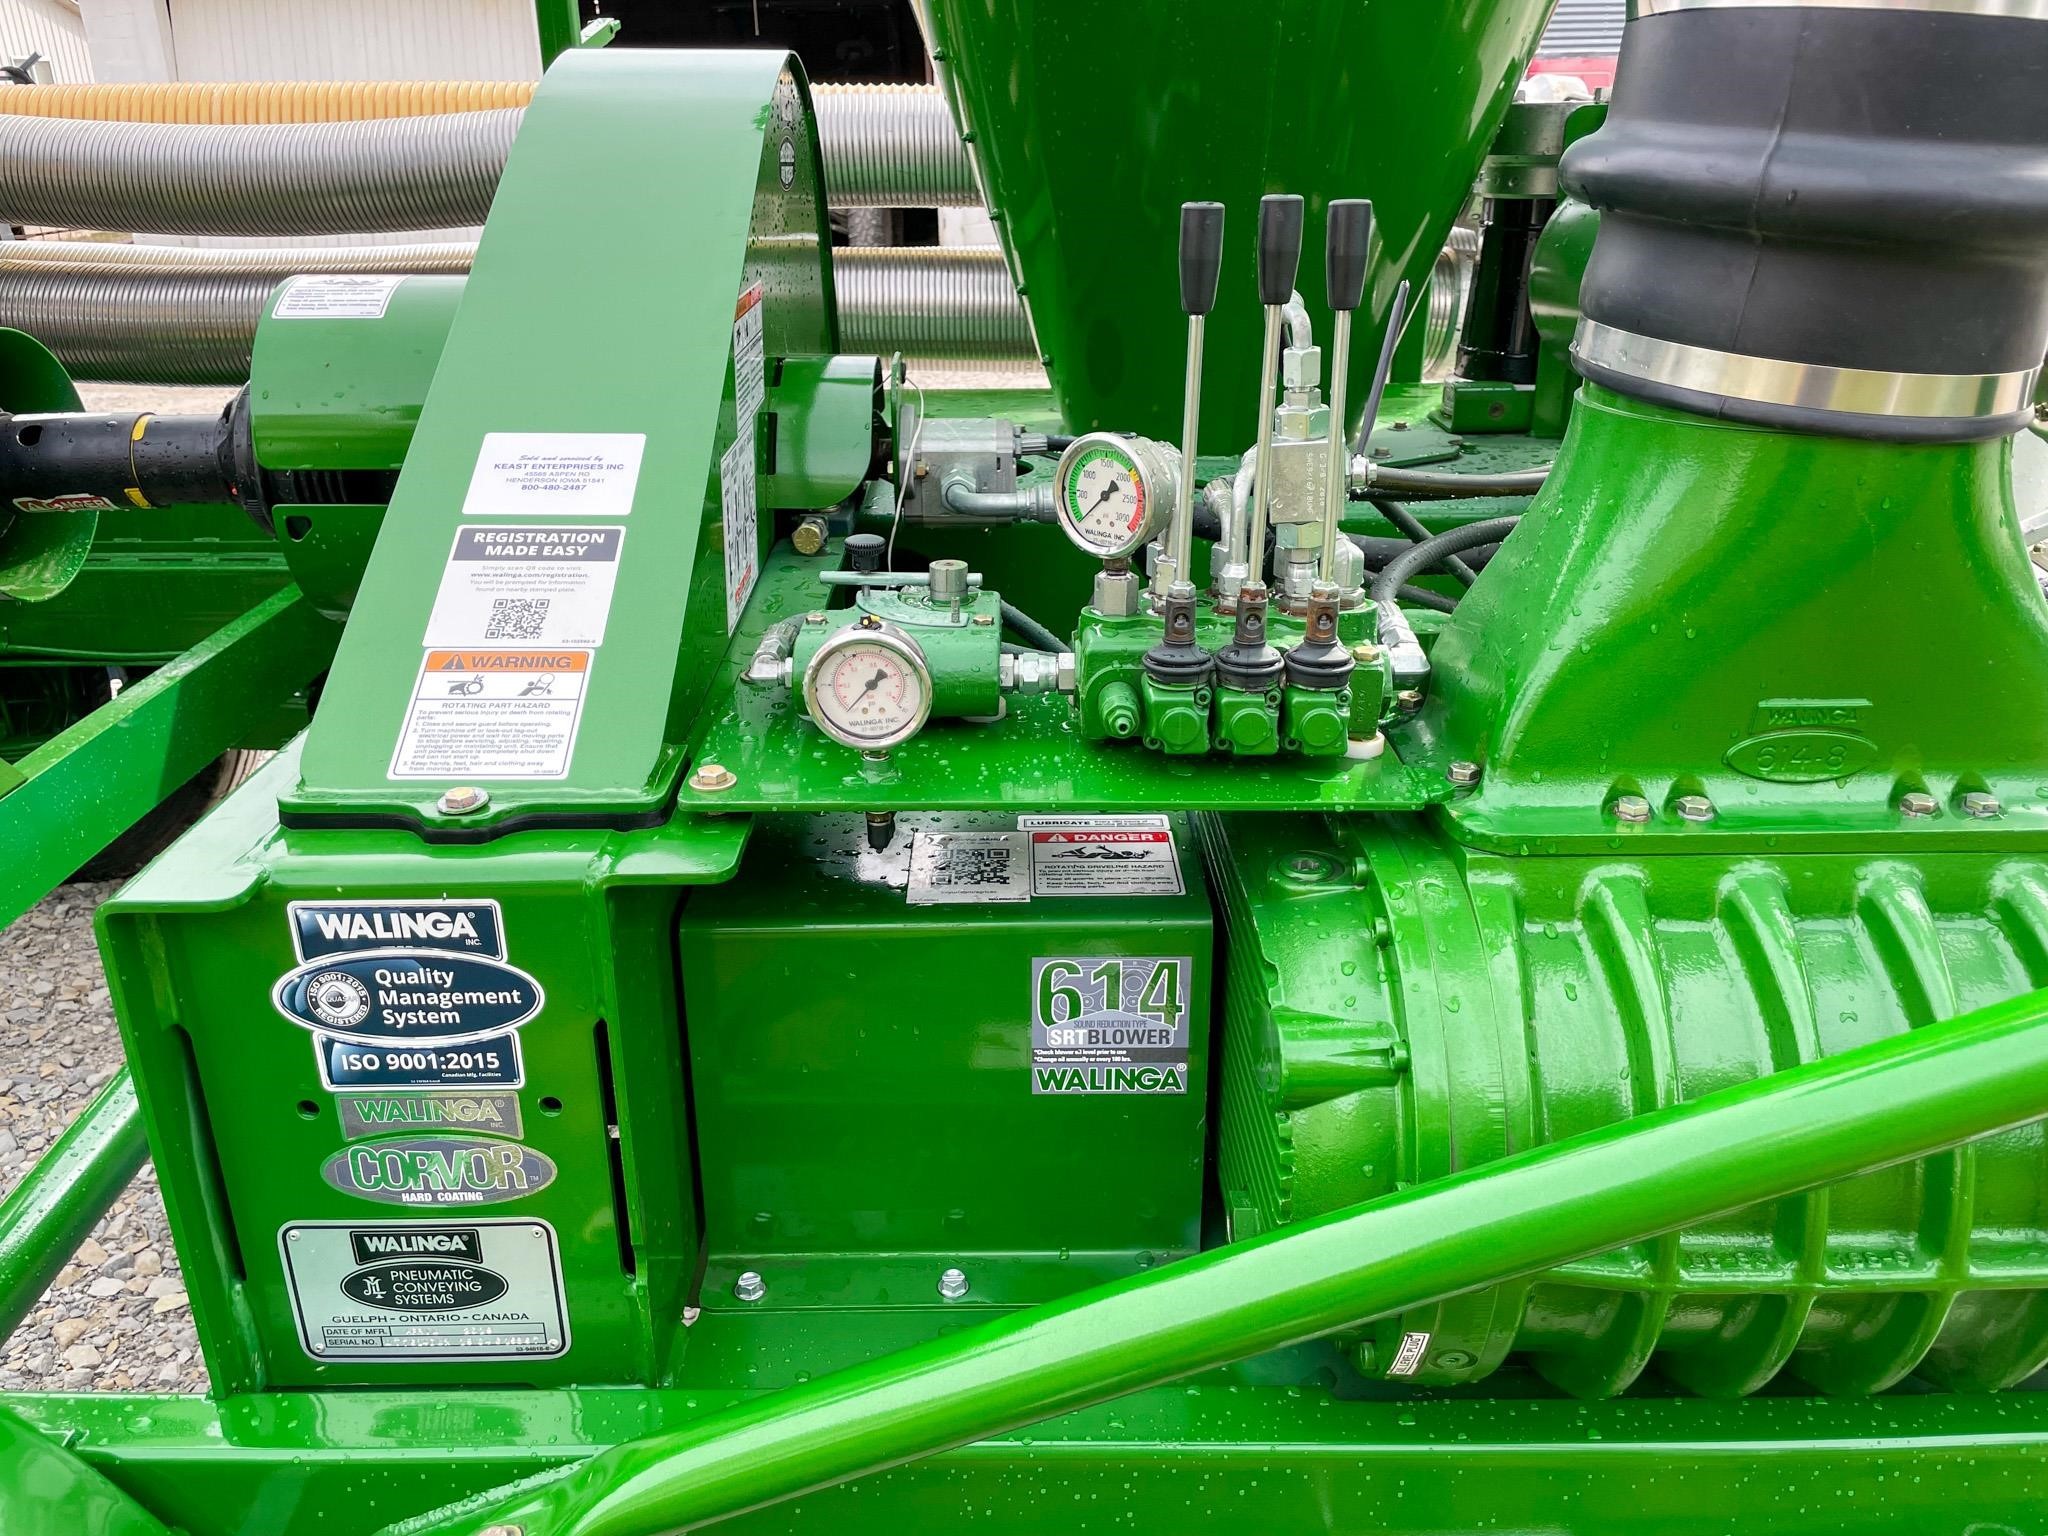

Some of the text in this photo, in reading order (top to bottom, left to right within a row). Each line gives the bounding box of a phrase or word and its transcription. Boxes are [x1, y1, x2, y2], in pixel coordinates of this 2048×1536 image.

[1100, 458, 1114, 468] 1500
[1083, 470, 1096, 480] 1000
[1116, 472, 1131, 482] 2000
[1122, 494, 1137, 504] 2500
[474, 532, 605, 543] REGISTRATION
[1085, 528, 1112, 539] WALINGA
[484, 545, 588, 556] MADE EASY
[472, 656, 571, 668] WARNING
[849, 719, 883, 727] WALINGA
[1757, 745, 1848, 771] 614-8
[315, 912, 479, 940] WALINGA
[374, 968, 454, 989] Quality
[378, 989, 521, 1008] Management
[1037, 960, 1185, 1030] 614
[316, 1005, 368, 1025] REGISTERED
[382, 1009, 461, 1028] System
[1073, 1020, 1148, 1028] SOUND REDUCTION TYPE
[342, 1052, 500, 1071] ISO 9001:2015
[1035, 1067, 1185, 1092] WALINGA
[354, 1099, 503, 1123] WALINGA
[348, 1145, 528, 1191] CORVOR
[402, 1192, 483, 1202] HARD COATING
[363, 1234, 468, 1252] WALINGA
[390, 1269, 474, 1281] PNEUMATIC
[392, 1281, 482, 1293] CONVEYING
[394, 1293, 455, 1305] SYSTEMS
[399, 1314, 461, 1323] ONTARIO
[472, 1313, 529, 1321] CANADA
